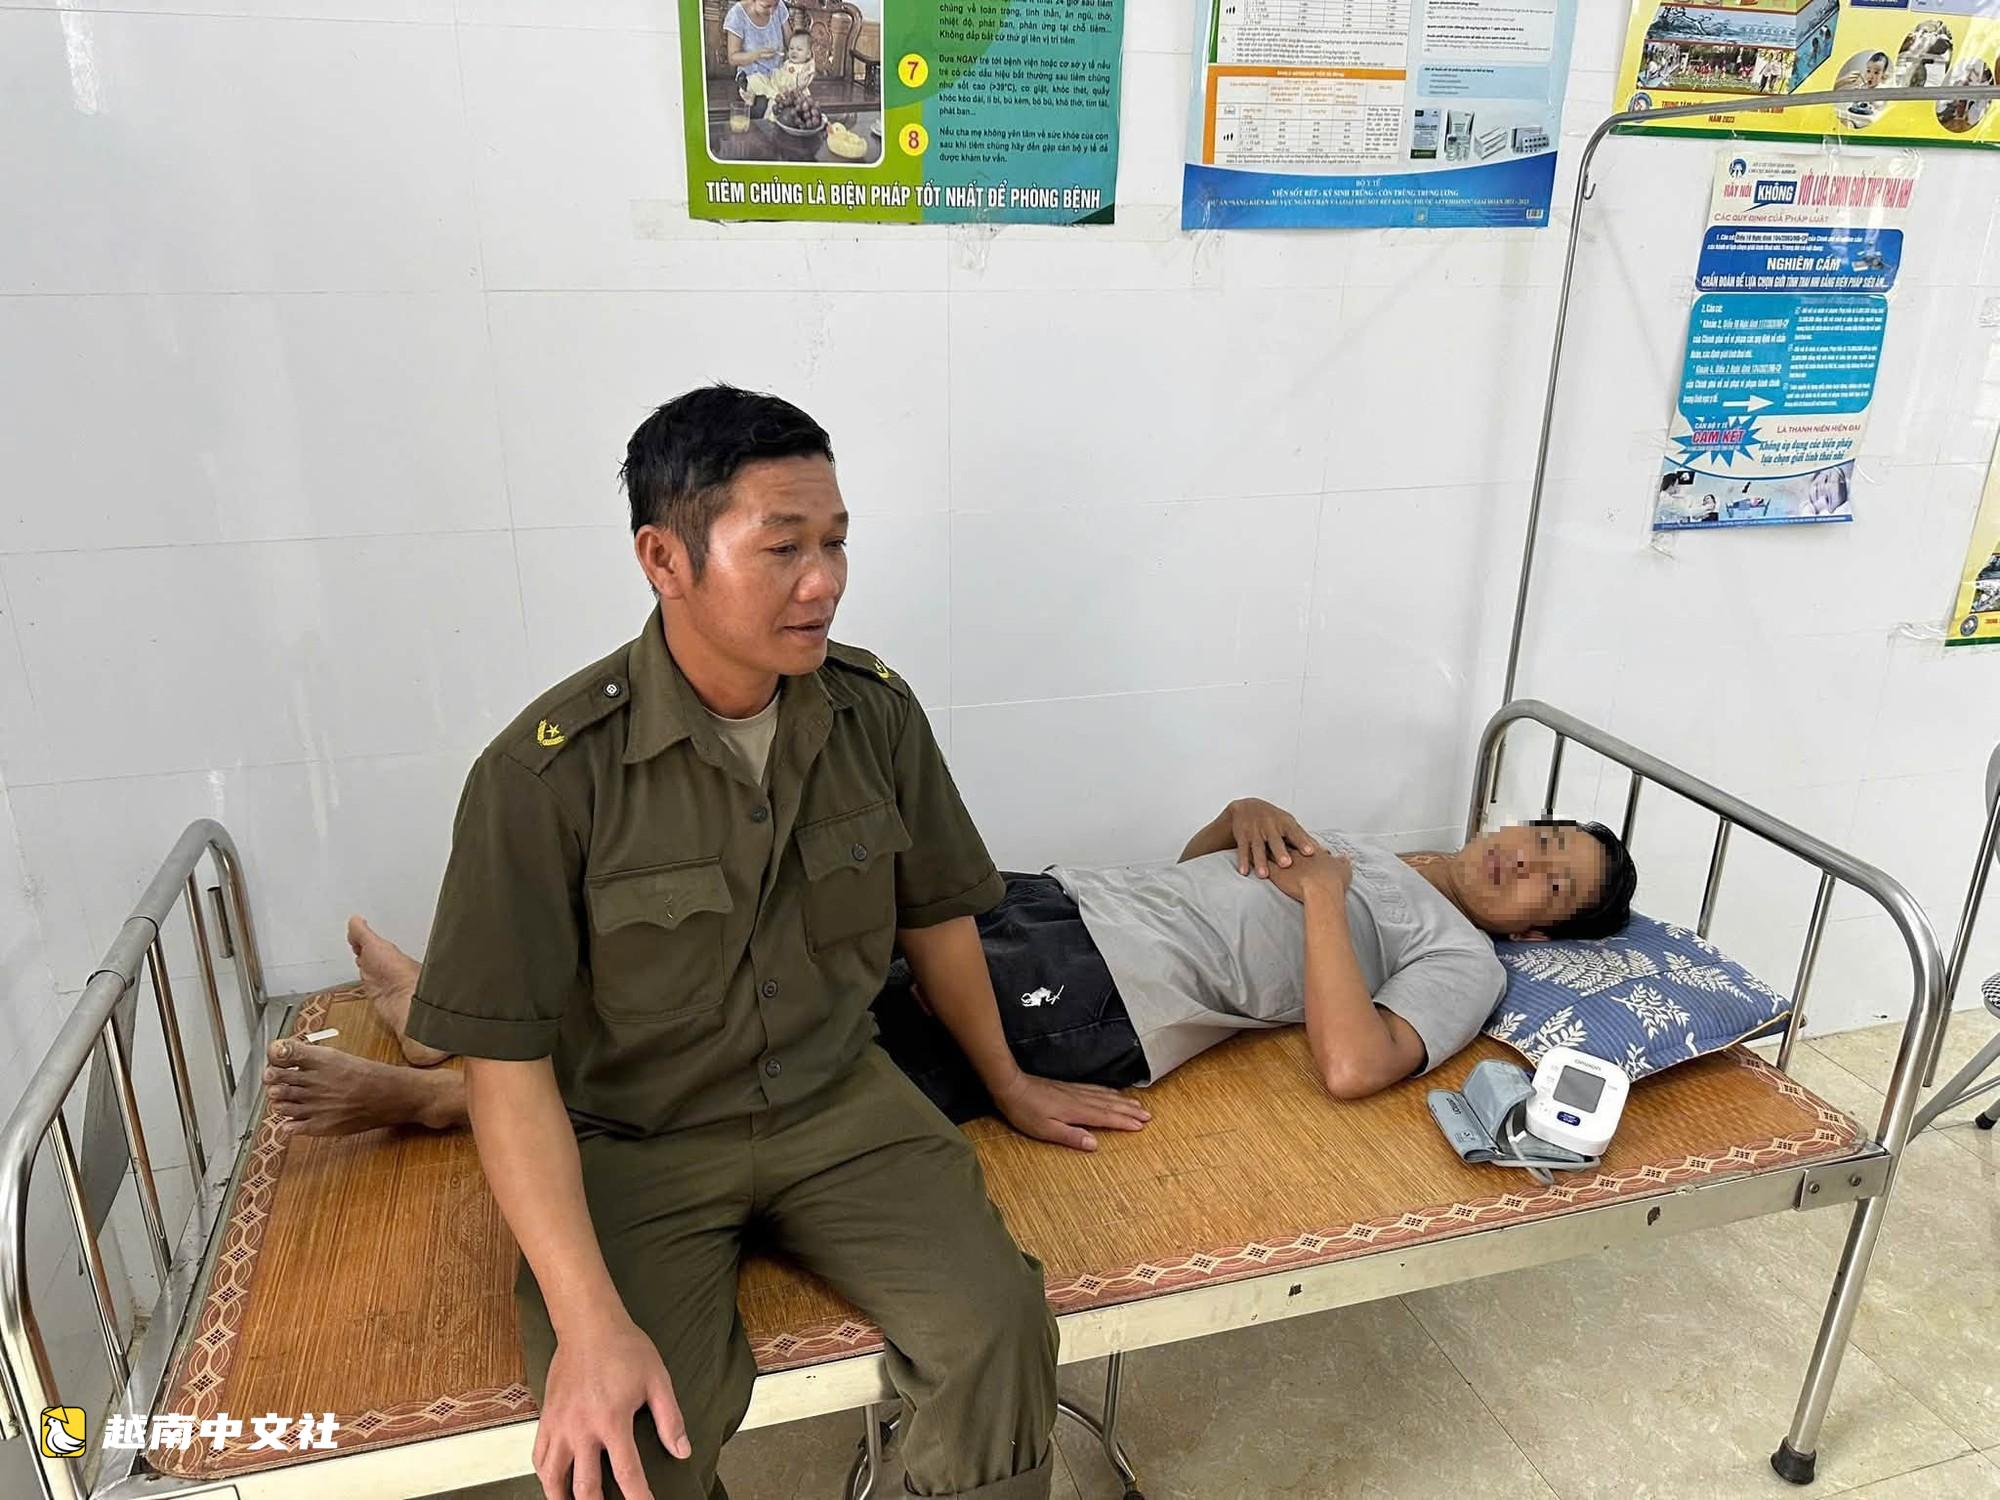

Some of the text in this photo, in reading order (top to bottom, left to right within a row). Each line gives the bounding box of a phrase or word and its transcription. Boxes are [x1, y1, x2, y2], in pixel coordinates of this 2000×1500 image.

[940, 30, 964, 40] Không
[957, 56, 978, 64] NGAY
[908, 61, 919, 80] 7
[1708, 114, 1721, 124] NĂM
[956, 128, 969, 136] cha
[984, 129, 1005, 138] không
[909, 130, 919, 149] 8
[956, 141, 966, 149] khi
[706, 176, 1100, 212] TIÊM CHỦNG LÀ BIỆN PHÁP TỐT NHẤT ĐỂ PHÒNG BỆNH
[1758, 183, 1793, 201] KHÔNG
[1714, 212, 1732, 221] CÁC
[1767, 254, 1841, 270] NGHIÊM CẤM
[1693, 427, 1744, 444] CAM KẾT
[1759, 440, 1781, 451] Không
